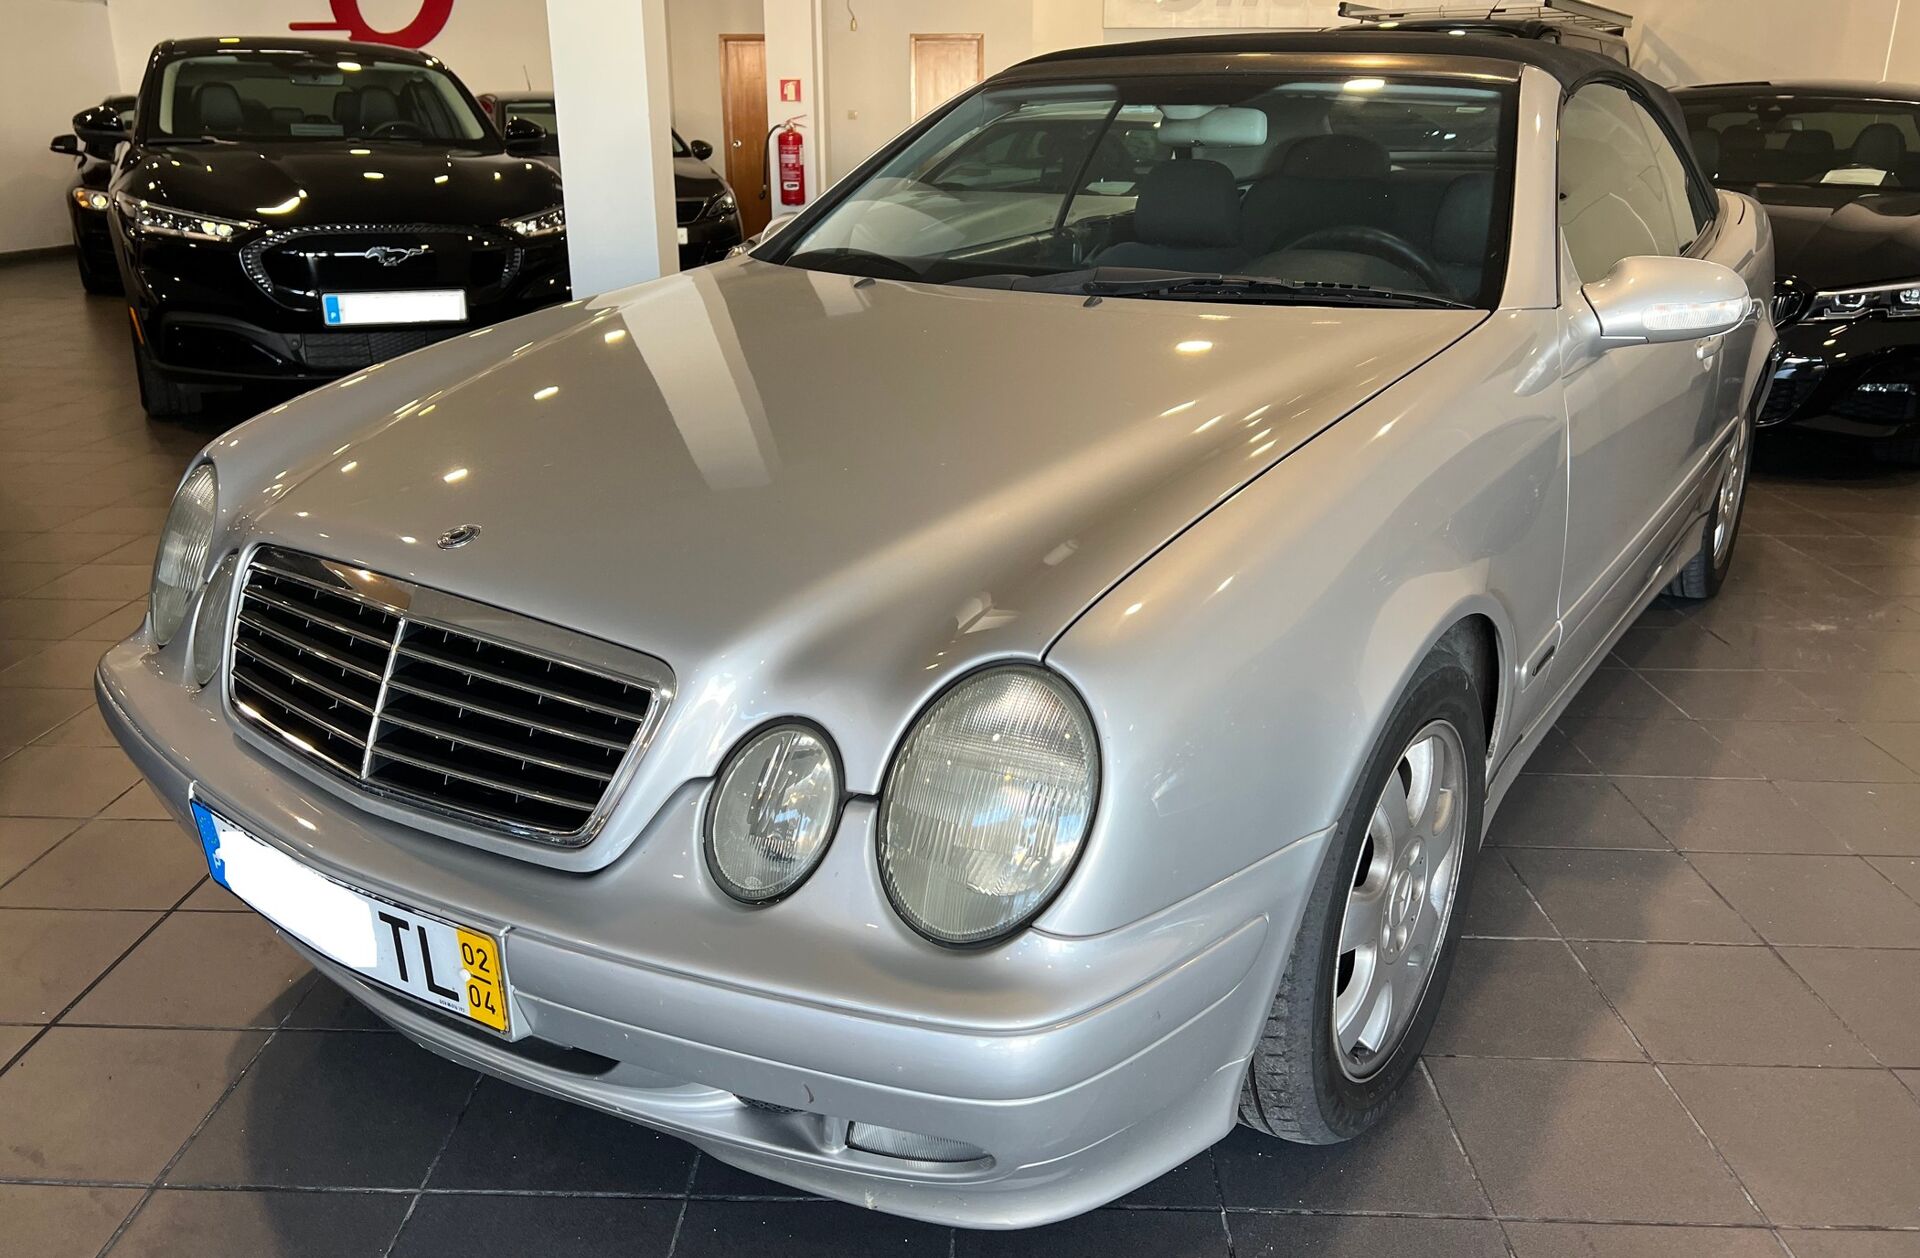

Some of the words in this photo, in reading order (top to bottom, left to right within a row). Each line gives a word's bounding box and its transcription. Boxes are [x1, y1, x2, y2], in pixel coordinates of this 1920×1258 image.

[378, 910, 460, 1002] TL
[461, 942, 490, 973] 02
[469, 984, 496, 1015] 04
